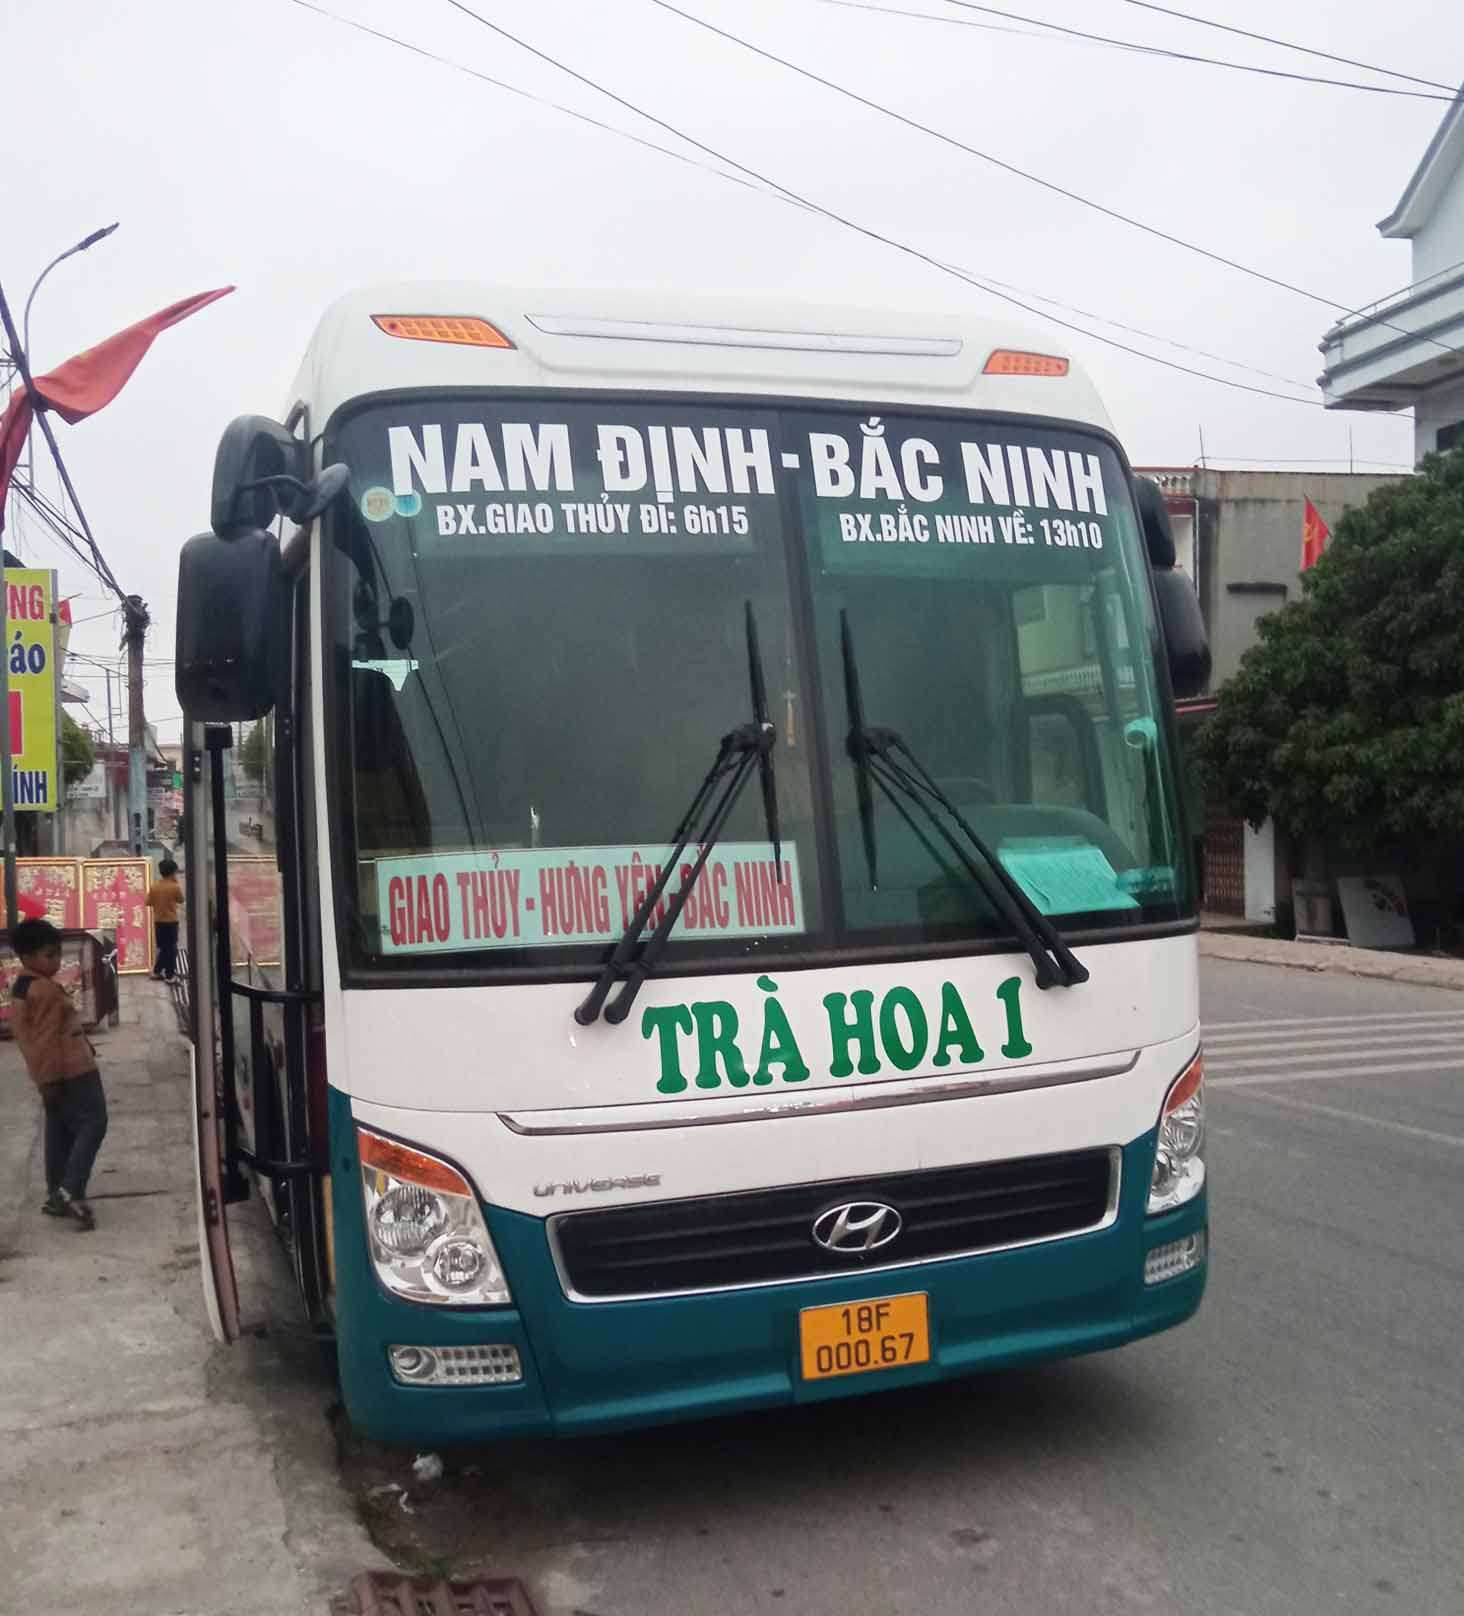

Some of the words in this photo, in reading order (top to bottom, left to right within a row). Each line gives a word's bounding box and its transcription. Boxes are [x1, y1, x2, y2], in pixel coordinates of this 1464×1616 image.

[388, 423, 575, 496] NAM
[960, 441, 1108, 516] NINH
[562, 492, 630, 534] THỦY
[683, 504, 749, 535] 6h15
[935, 514, 995, 544] NINH
[1039, 518, 1103, 549] 13h10
[4, 581, 44, 620] NG
[388, 872, 450, 946] GIAO
[456, 852, 521, 940] THỦY
[538, 859, 611, 936] HƯNG
[734, 860, 796, 929] NINH
[641, 974, 810, 1094] TRÀ
[823, 981, 984, 1078] HOA
[997, 976, 1033, 1059] 1
[841, 1303, 891, 1336] 18F
[816, 1332, 914, 1373] 000.67
